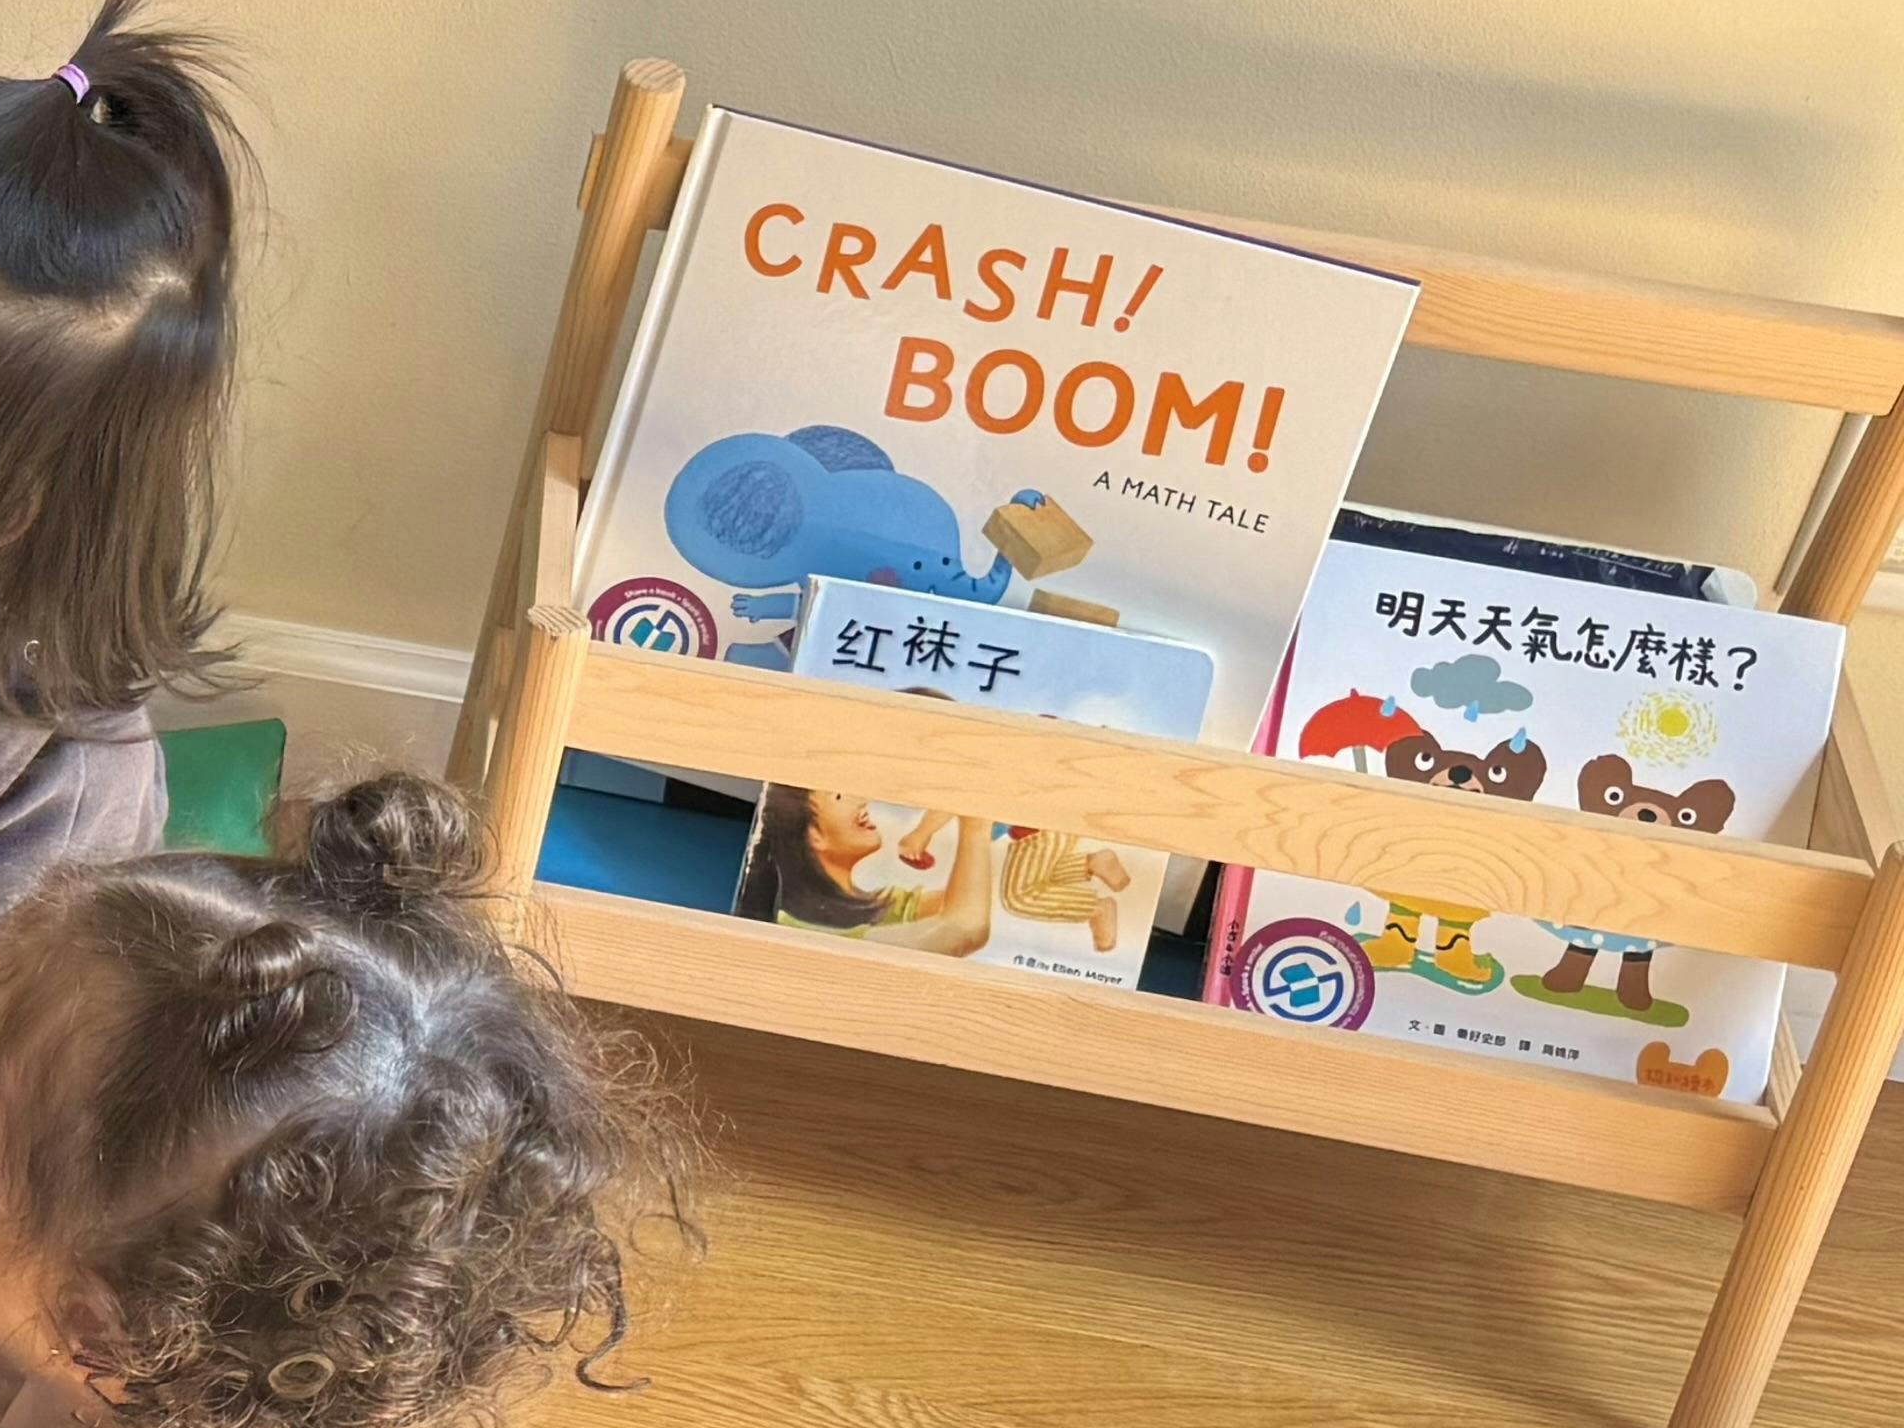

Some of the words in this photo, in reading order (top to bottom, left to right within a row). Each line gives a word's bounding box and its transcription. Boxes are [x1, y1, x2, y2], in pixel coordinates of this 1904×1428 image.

[744, 203, 1164, 333] CRASH!
[884, 336, 1285, 473] BOOM!
[1093, 470, 1110, 490] A
[1121, 476, 1197, 514] MATH
[1207, 499, 1269, 534] TALE
[832, 616, 1021, 692] 红袜子
[1375, 591, 1759, 691] 明天天氣怎麼樣？
